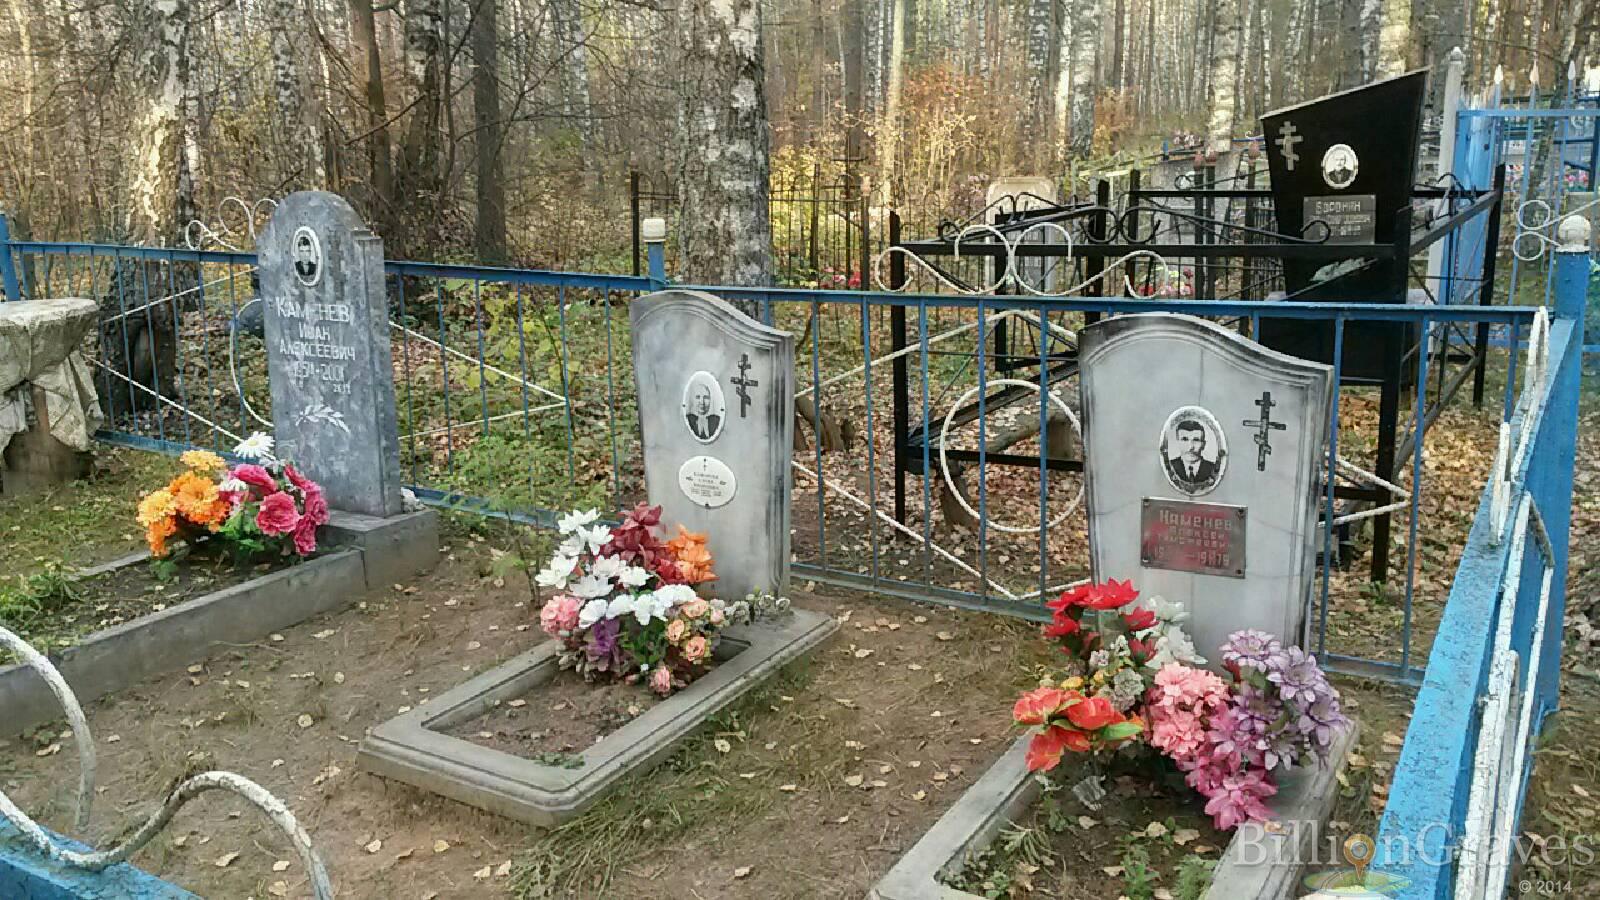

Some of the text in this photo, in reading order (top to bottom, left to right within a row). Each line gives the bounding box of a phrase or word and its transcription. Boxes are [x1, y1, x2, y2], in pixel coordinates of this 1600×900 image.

[275, 296, 350, 322] КАМЕНЕВ
[299, 321, 331, 341] ИВАН
[279, 339, 356, 361] АЛЕКСЕЕВИЧ
